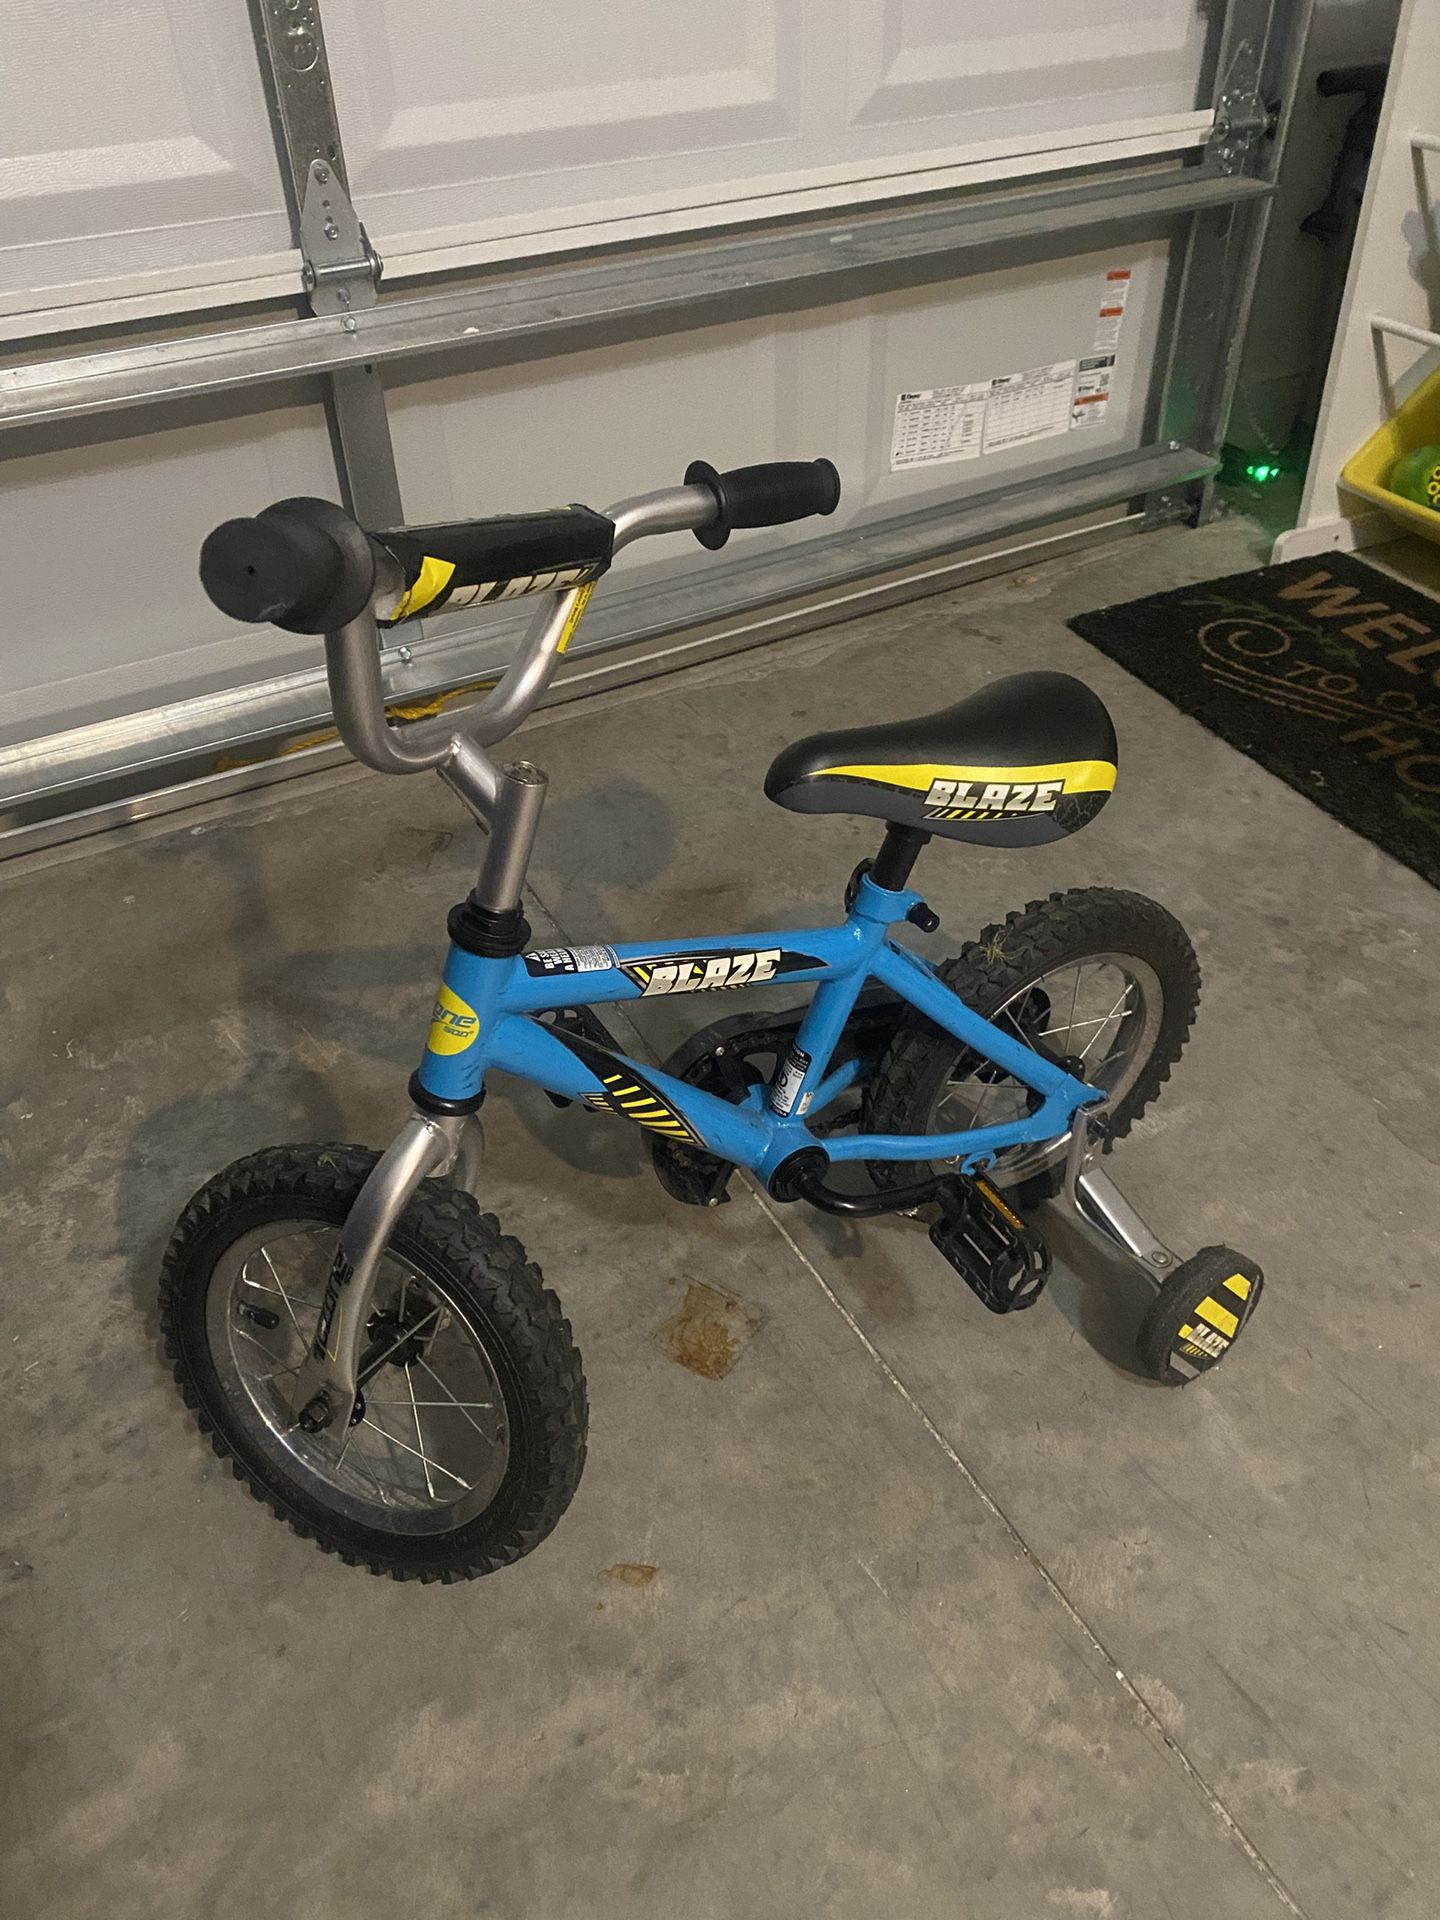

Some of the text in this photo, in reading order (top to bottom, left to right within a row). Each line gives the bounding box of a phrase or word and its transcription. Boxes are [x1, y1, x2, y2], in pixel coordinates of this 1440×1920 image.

[1277, 570, 1440, 690] WEL
[1286, 661, 1360, 694] TO
[923, 779, 1064, 811] BLAZE
[542, 956, 555, 970] BE
[642, 949, 782, 997] BLAZE
[1186, 1322, 1231, 1359] BLAZE
